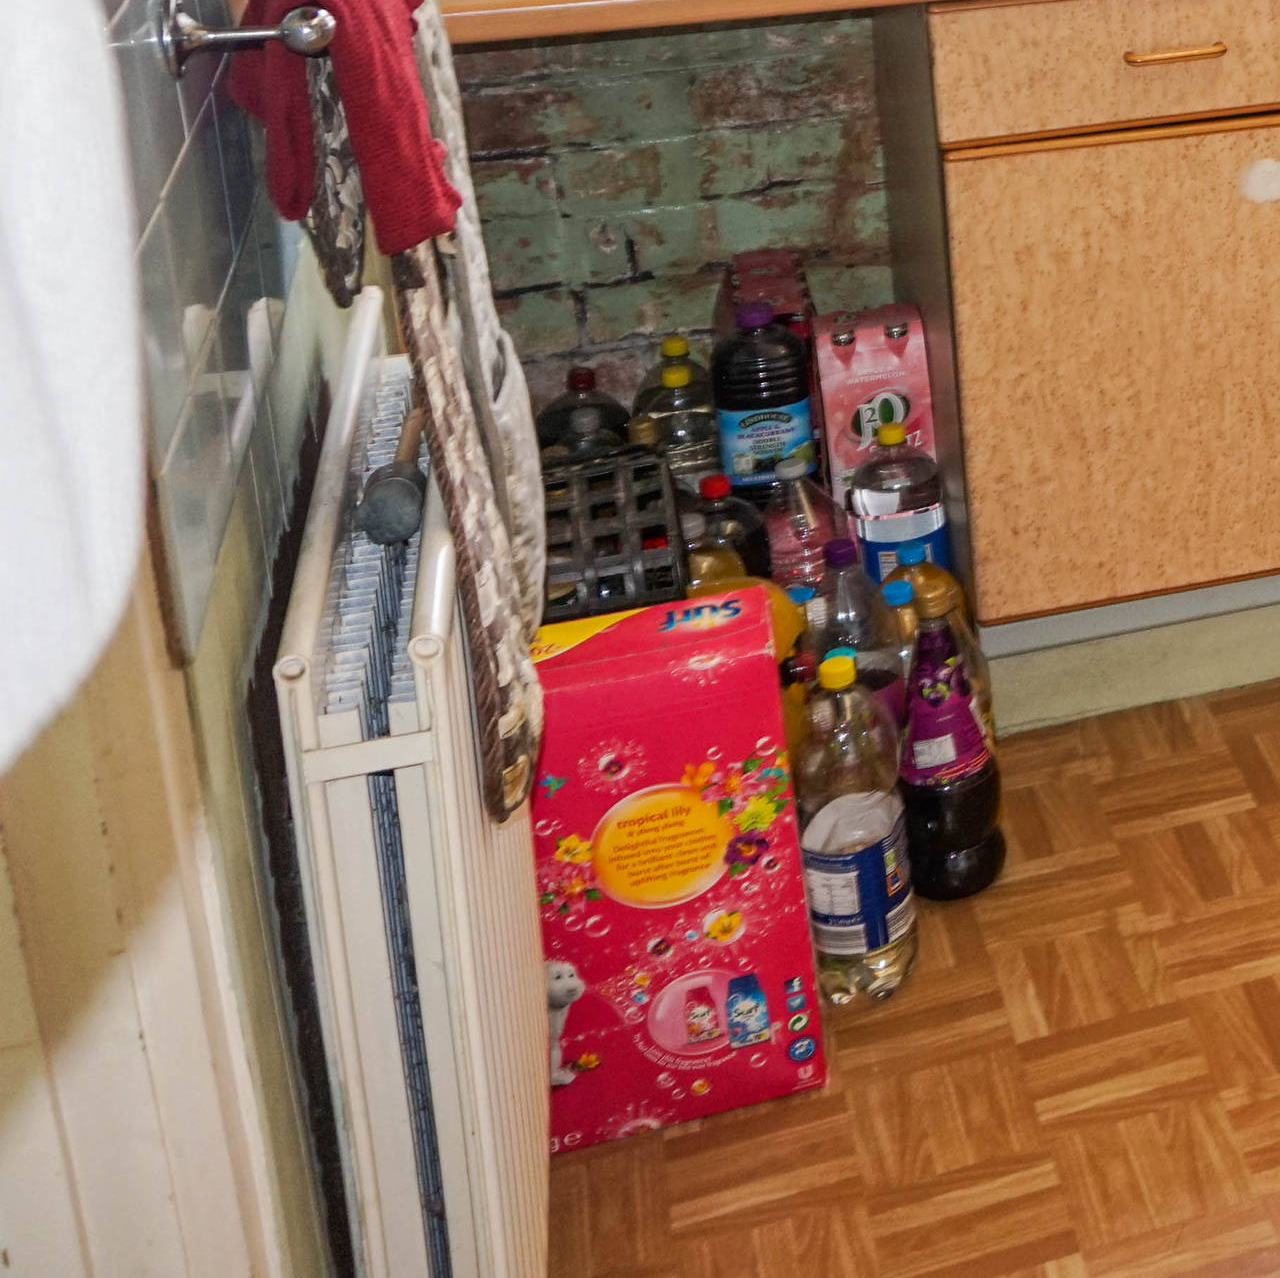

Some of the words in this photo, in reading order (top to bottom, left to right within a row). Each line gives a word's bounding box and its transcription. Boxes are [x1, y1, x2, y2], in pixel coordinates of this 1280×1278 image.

[657, 599, 742, 631] Surf
[616, 809, 668, 829] tropical
[671, 806, 692, 818] lily
